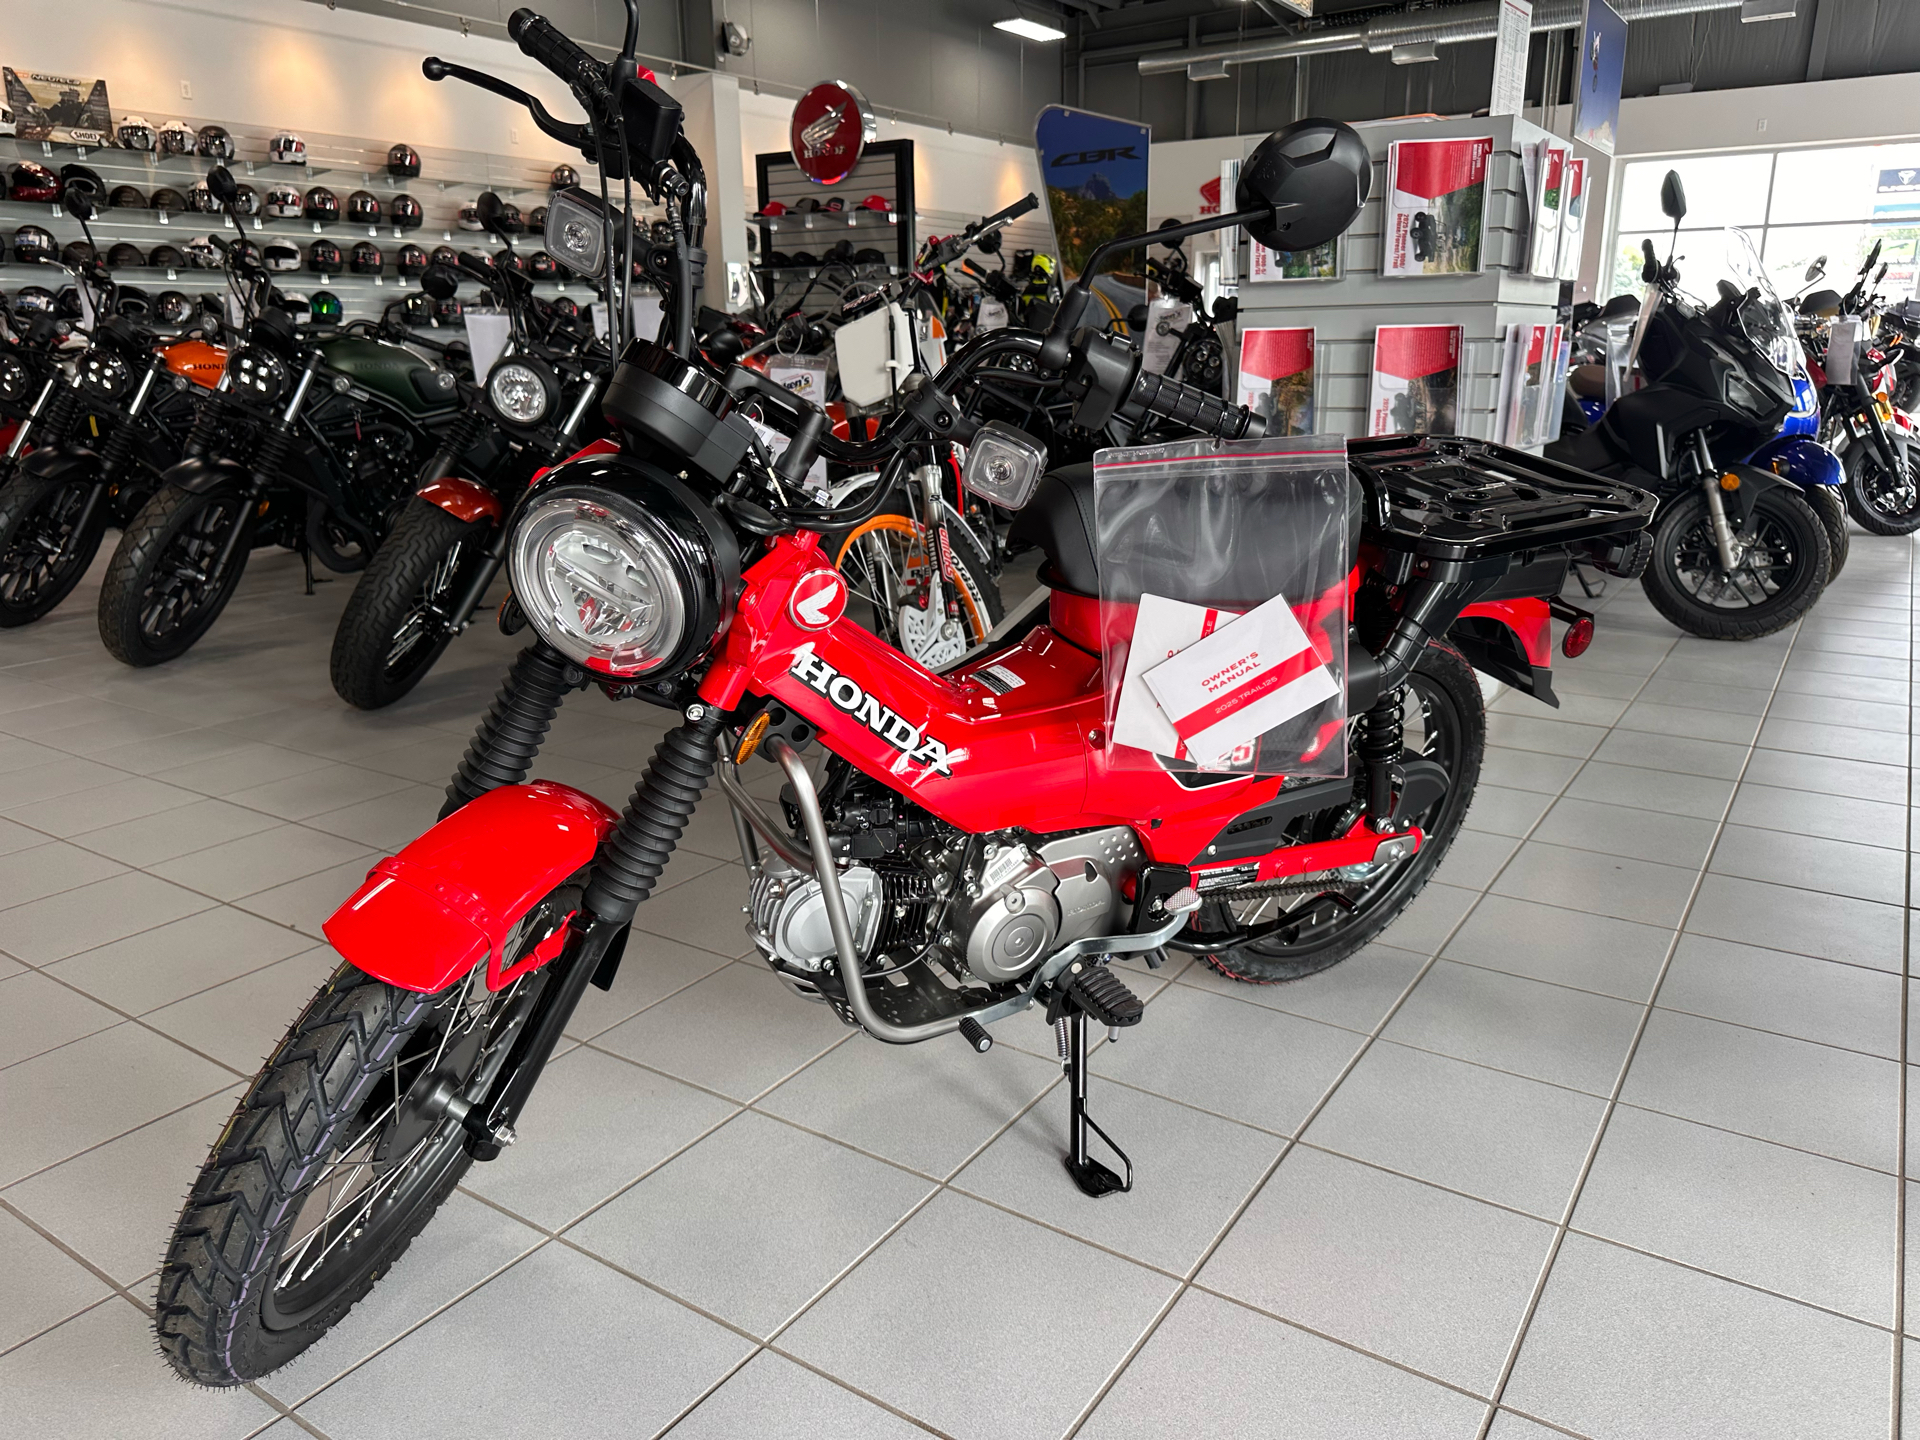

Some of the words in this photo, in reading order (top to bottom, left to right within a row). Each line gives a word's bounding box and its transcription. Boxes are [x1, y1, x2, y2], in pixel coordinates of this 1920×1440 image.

[74, 131, 97, 140] SHOEI
[1050, 146, 1142, 168] CBR
[1402, 213, 1410, 229] 2025
[1400, 229, 1408, 251] Pioneer
[353, 361, 401, 373] HONDA
[1201, 651, 1259, 688] OWNER'S
[1207, 661, 1261, 693] MANUAL
[1214, 697, 1239, 715] 2025
[1237, 675, 1278, 701] TRAIL125
[789, 650, 952, 779] HONDA
